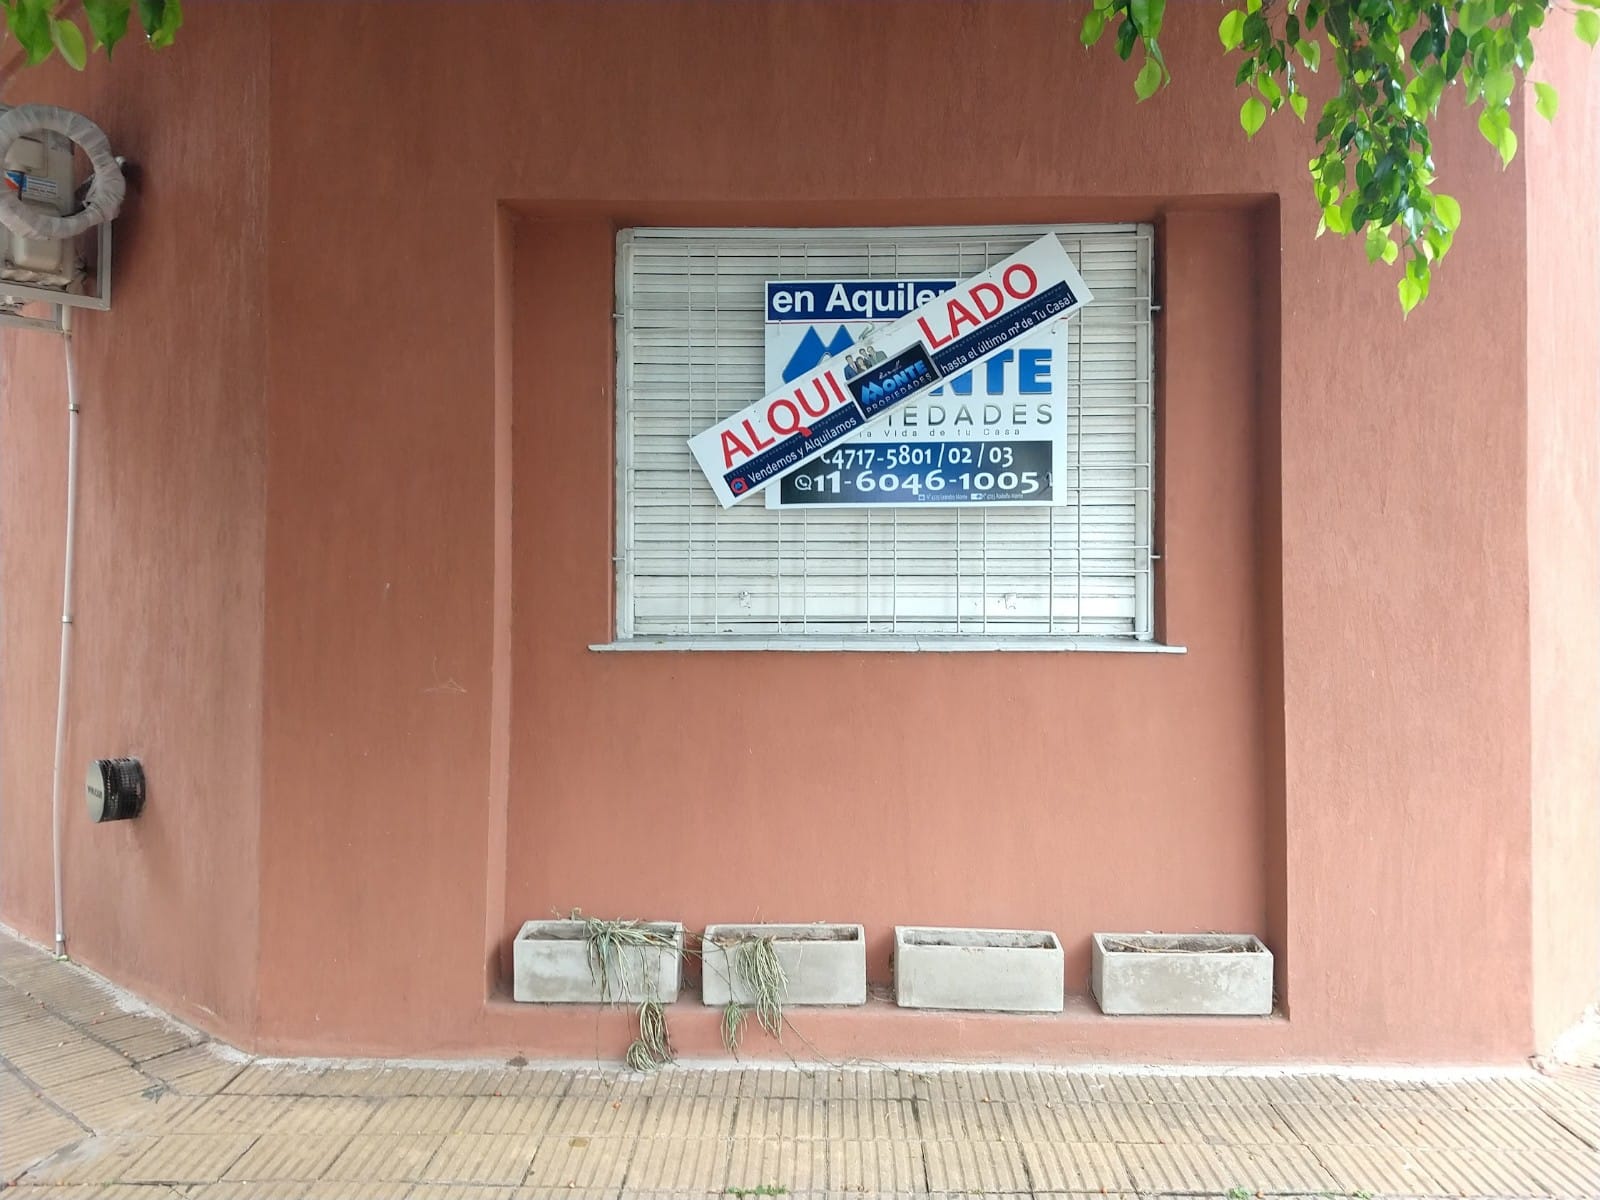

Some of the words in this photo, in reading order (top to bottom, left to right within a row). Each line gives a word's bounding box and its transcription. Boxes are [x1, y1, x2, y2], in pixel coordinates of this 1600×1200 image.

[772, 290, 815, 313] en
[941, 354, 968, 374] hasta
[968, 347, 979, 359] el
[978, 332, 1007, 353] último
[1007, 321, 1021, 337] m²
[1021, 317, 1034, 329] de
[1031, 309, 1047, 322] Tu
[1045, 292, 1075, 314] Casa!
[720, 370, 847, 470] ALQUI
[918, 264, 1038, 350] LADO
[861, 360, 928, 405] MONTE
[866, 372, 933, 413] PROPIEDADES
[748, 450, 798, 483] Vendemos
[798, 447, 805, 459] y
[804, 416, 857, 453] Alquilamos
[929, 428, 946, 437] de
[957, 428, 971, 437] tu
[983, 427, 1021, 437] Casa
[832, 444, 932, 470] 4717-5801
[948, 447, 973, 465] 02
[988, 446, 1013, 468] 03
[813, 469, 1040, 496] 11-6046-1005
